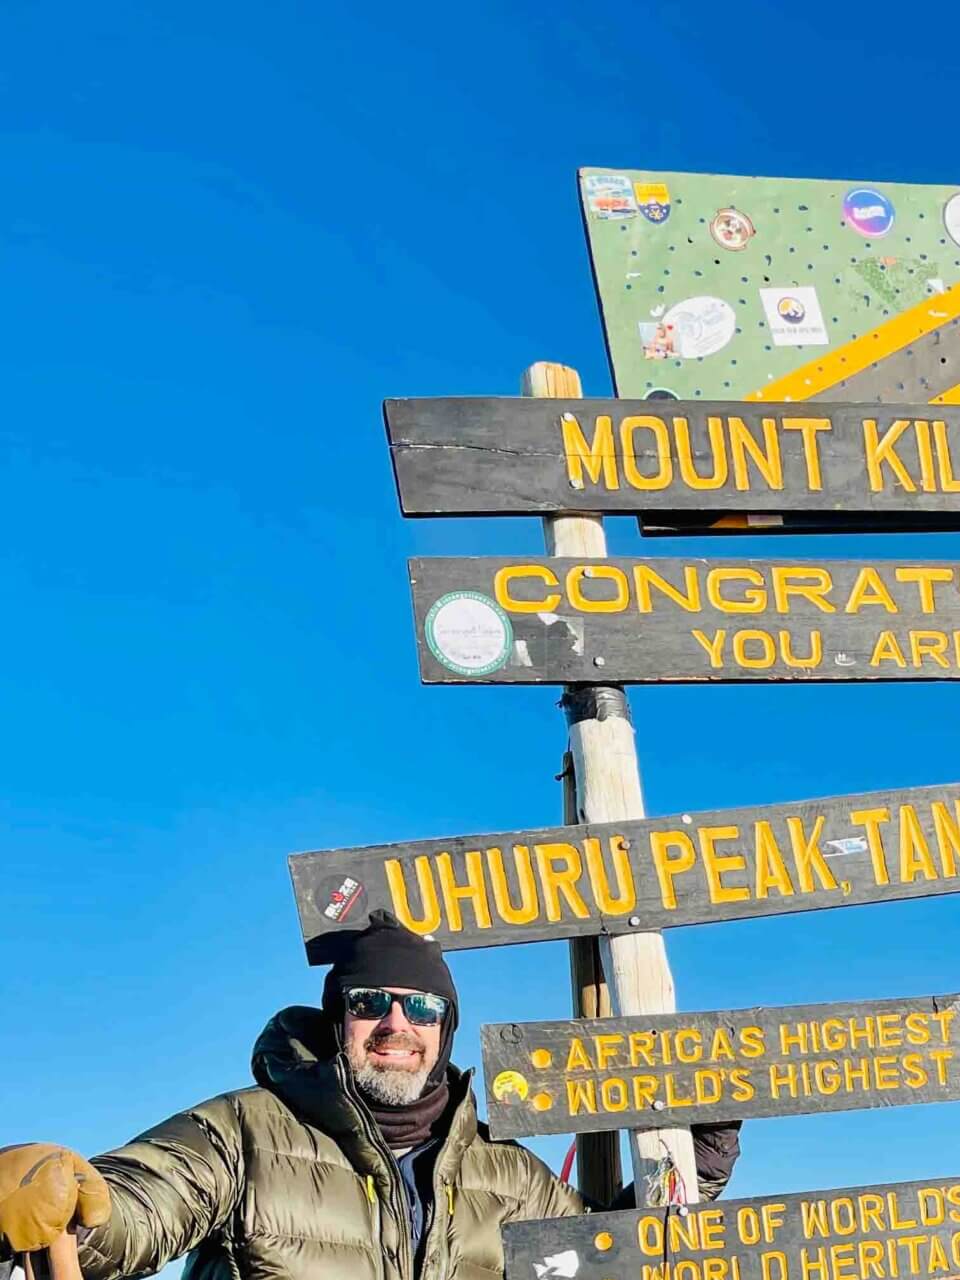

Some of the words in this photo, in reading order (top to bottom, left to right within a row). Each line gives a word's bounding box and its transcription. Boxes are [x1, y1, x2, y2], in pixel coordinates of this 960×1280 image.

[560, 414, 832, 491] MOUNT
[692, 629, 823, 669] YOU
[383, 835, 640, 935] UHURU
[650, 814, 851, 912] PEAK,
[778, 1010, 957, 1055] HIGHEST
[567, 1064, 756, 1115] WORLD'S
[768, 1050, 953, 1098] HIGHEST
[637, 1208, 725, 1256] ONE
[736, 1203, 787, 1245] OF
